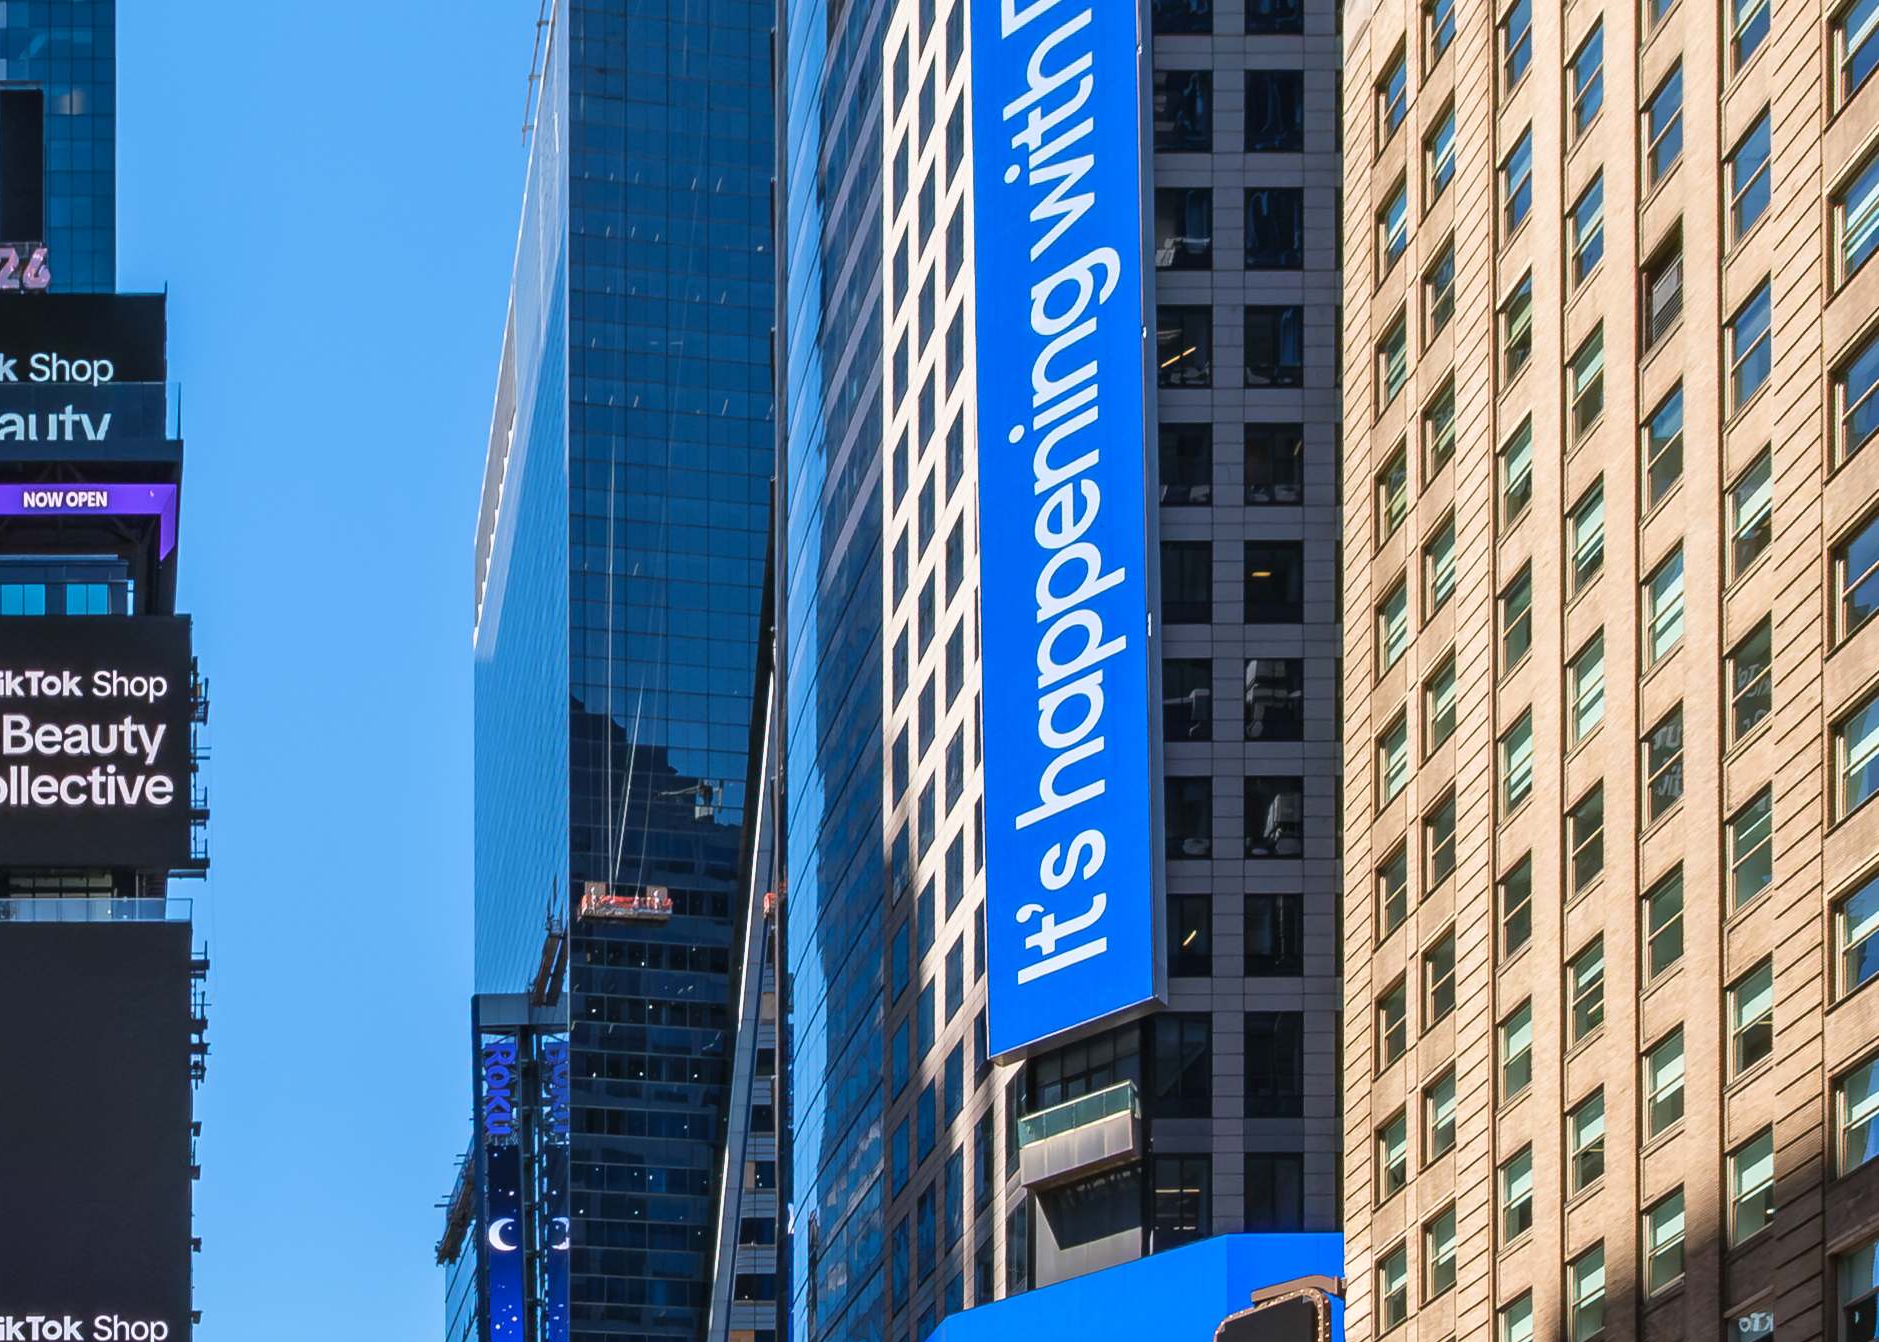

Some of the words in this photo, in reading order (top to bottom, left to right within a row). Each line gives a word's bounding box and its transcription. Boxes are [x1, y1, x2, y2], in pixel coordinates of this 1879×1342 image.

[1003, 8, 1095, 260] with
[29, 353, 113, 387] Shop
[24, 492, 58, 507] NOW
[63, 492, 107, 507] OPEN
[1008, 247, 1122, 827] happening
[92, 670, 167, 703] Shop
[484, 1043, 516, 1134] ROKU
